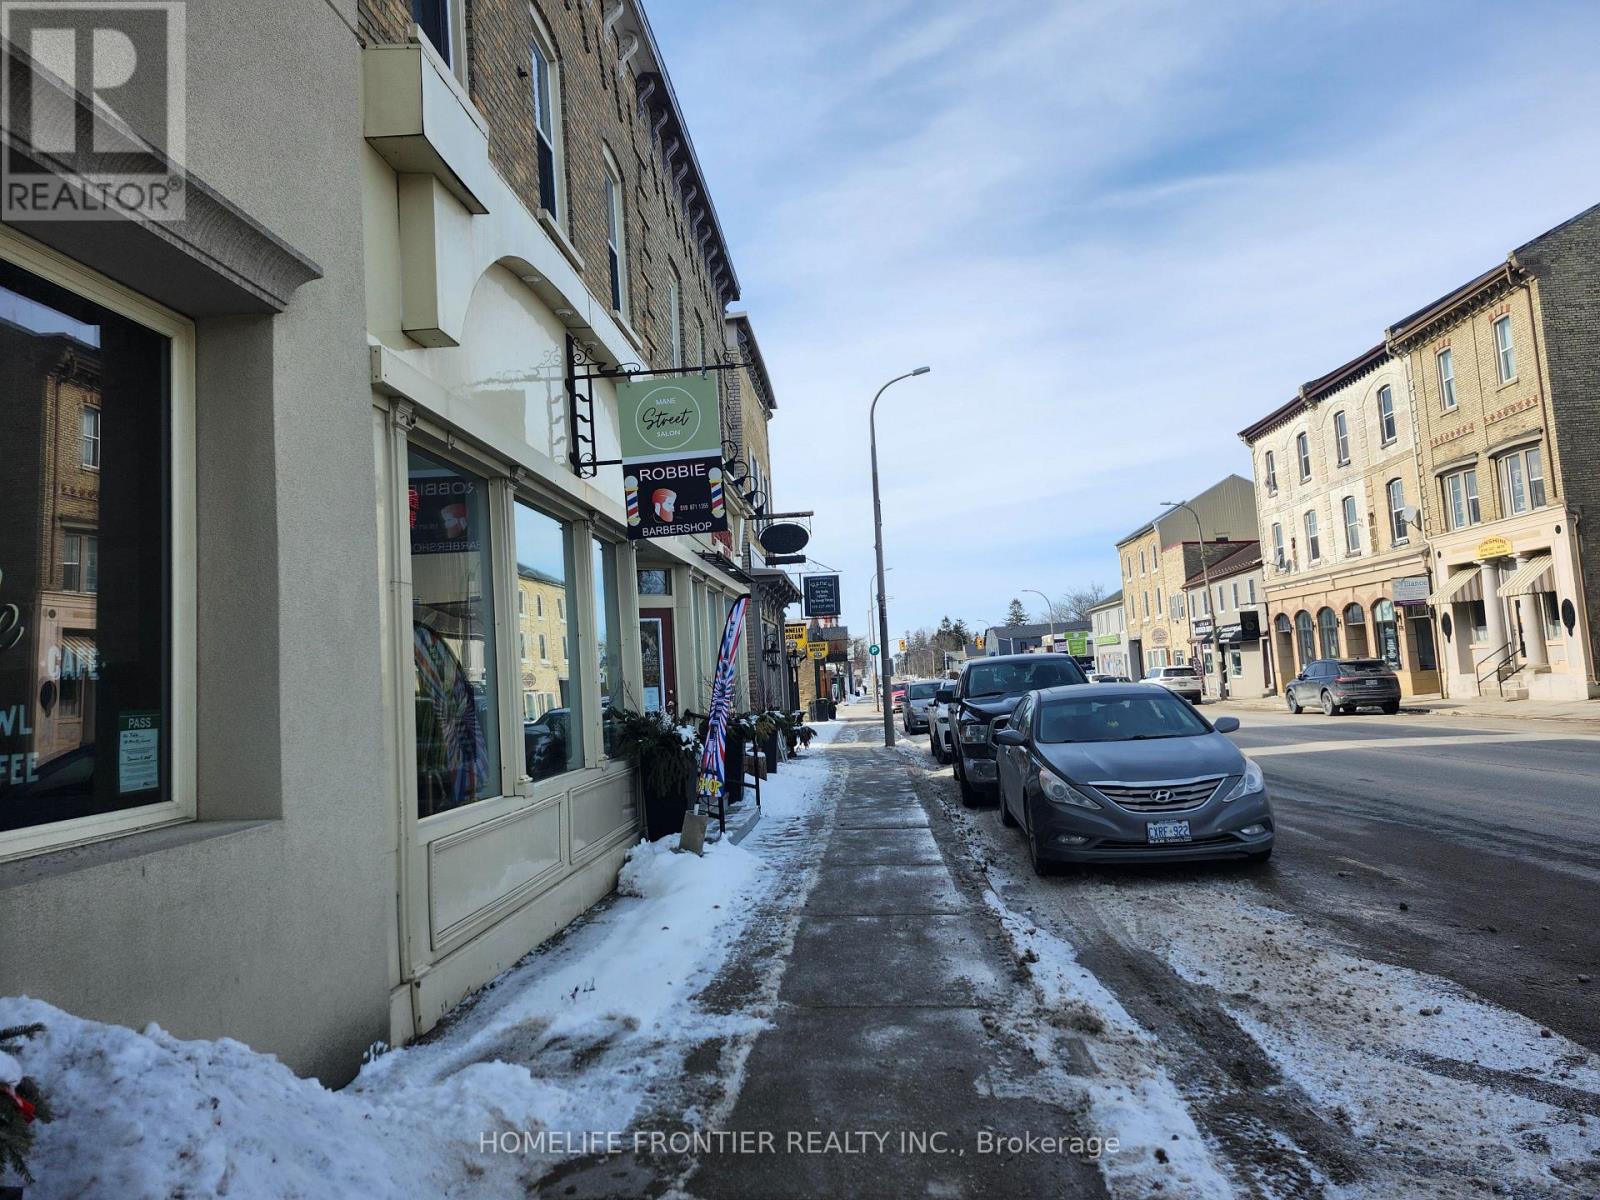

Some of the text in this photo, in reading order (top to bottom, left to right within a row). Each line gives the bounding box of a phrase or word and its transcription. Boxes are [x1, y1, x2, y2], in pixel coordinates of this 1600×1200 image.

[656, 397, 676, 406] MANE
[642, 407, 693, 430] Street
[656, 430, 681, 438] SALON
[639, 463, 706, 482] ROBBIE
[642, 521, 712, 537] BARBERSHOP
[128, 717, 152, 729] PASS
[1173, 825, 1189, 837] 922
